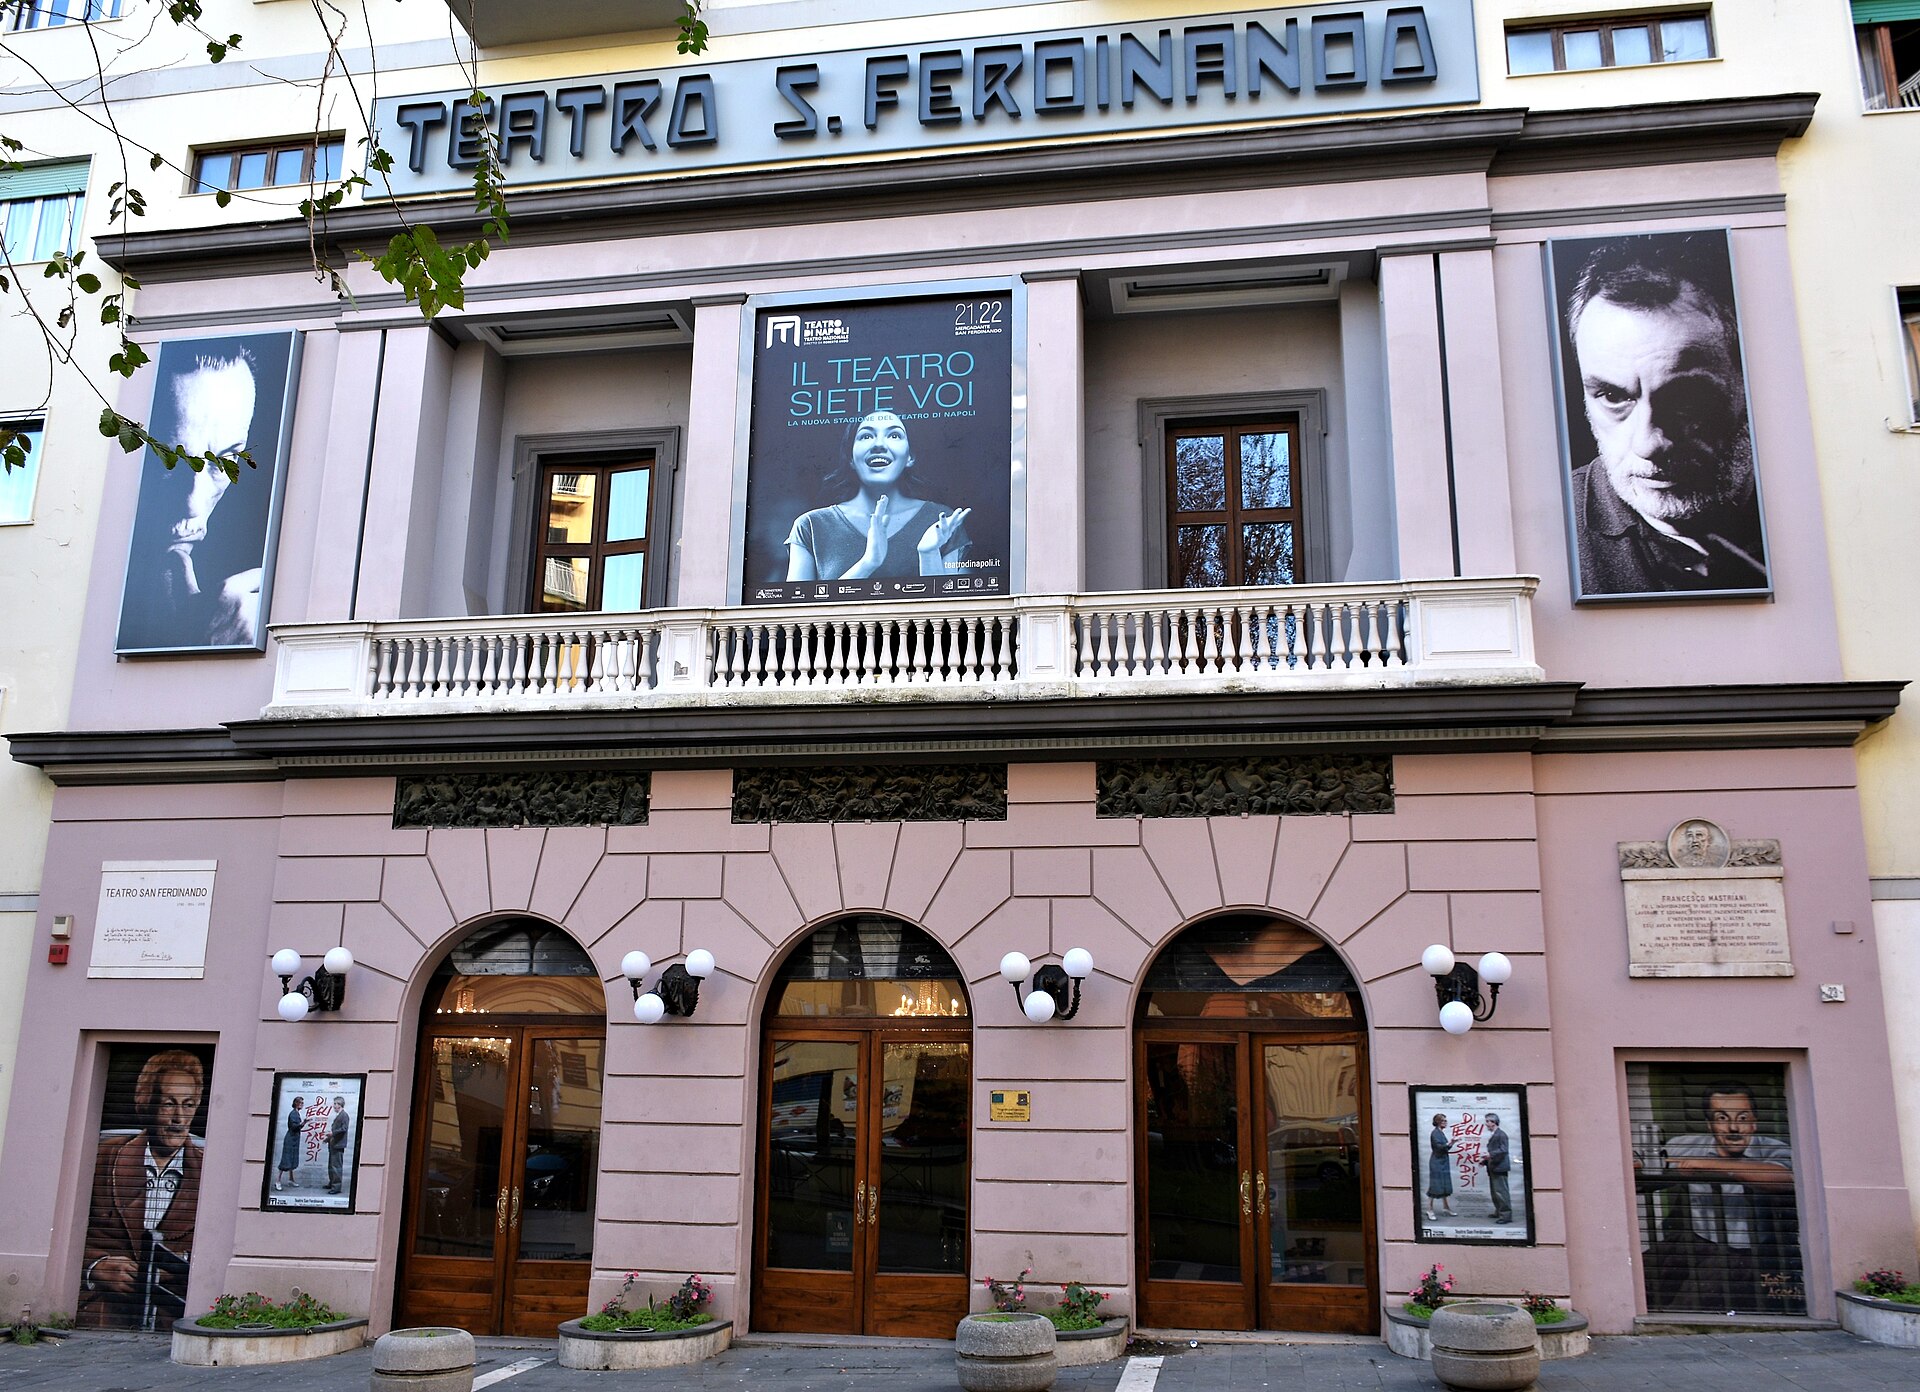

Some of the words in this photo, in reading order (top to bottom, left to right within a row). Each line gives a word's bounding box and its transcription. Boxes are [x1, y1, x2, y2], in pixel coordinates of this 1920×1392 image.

[396, 73, 718, 173] TEATRO
[955, 301, 1002, 325] 21.22
[804, 319, 842, 330] TEATRO
[804, 329, 813, 337] DI
[815, 327, 849, 337] NAPOLI
[792, 361, 819, 387] IL
[828, 351, 975, 384] TEATRO
[789, 385, 894, 417] SIETE
[908, 381, 974, 409] VOI
[801, 418, 831, 426] NUOVA
[833, 415, 875, 424] STAGIONE
[896, 412, 930, 421] TEATRO
[932, 411, 942, 419] DI
[943, 410, 976, 418] NAPOLI
[944, 559, 1001, 569] teatrodinapoli.it
[106, 888, 137, 898] TEATRO
[139, 888, 156, 898] SAN
[157, 888, 208, 898] FERDINANDO
[314, 1096, 327, 1106] DI
[1461, 1113, 1476, 1125] DI
[301, 1122, 327, 1133] SEM
[1451, 1124, 1485, 1136] TEGLI
[305, 1132, 325, 1143] PRE
[1448, 1142, 1481, 1154] SEM
[1456, 1153, 1480, 1166] PRE
[1459, 1165, 1475, 1173] DI
